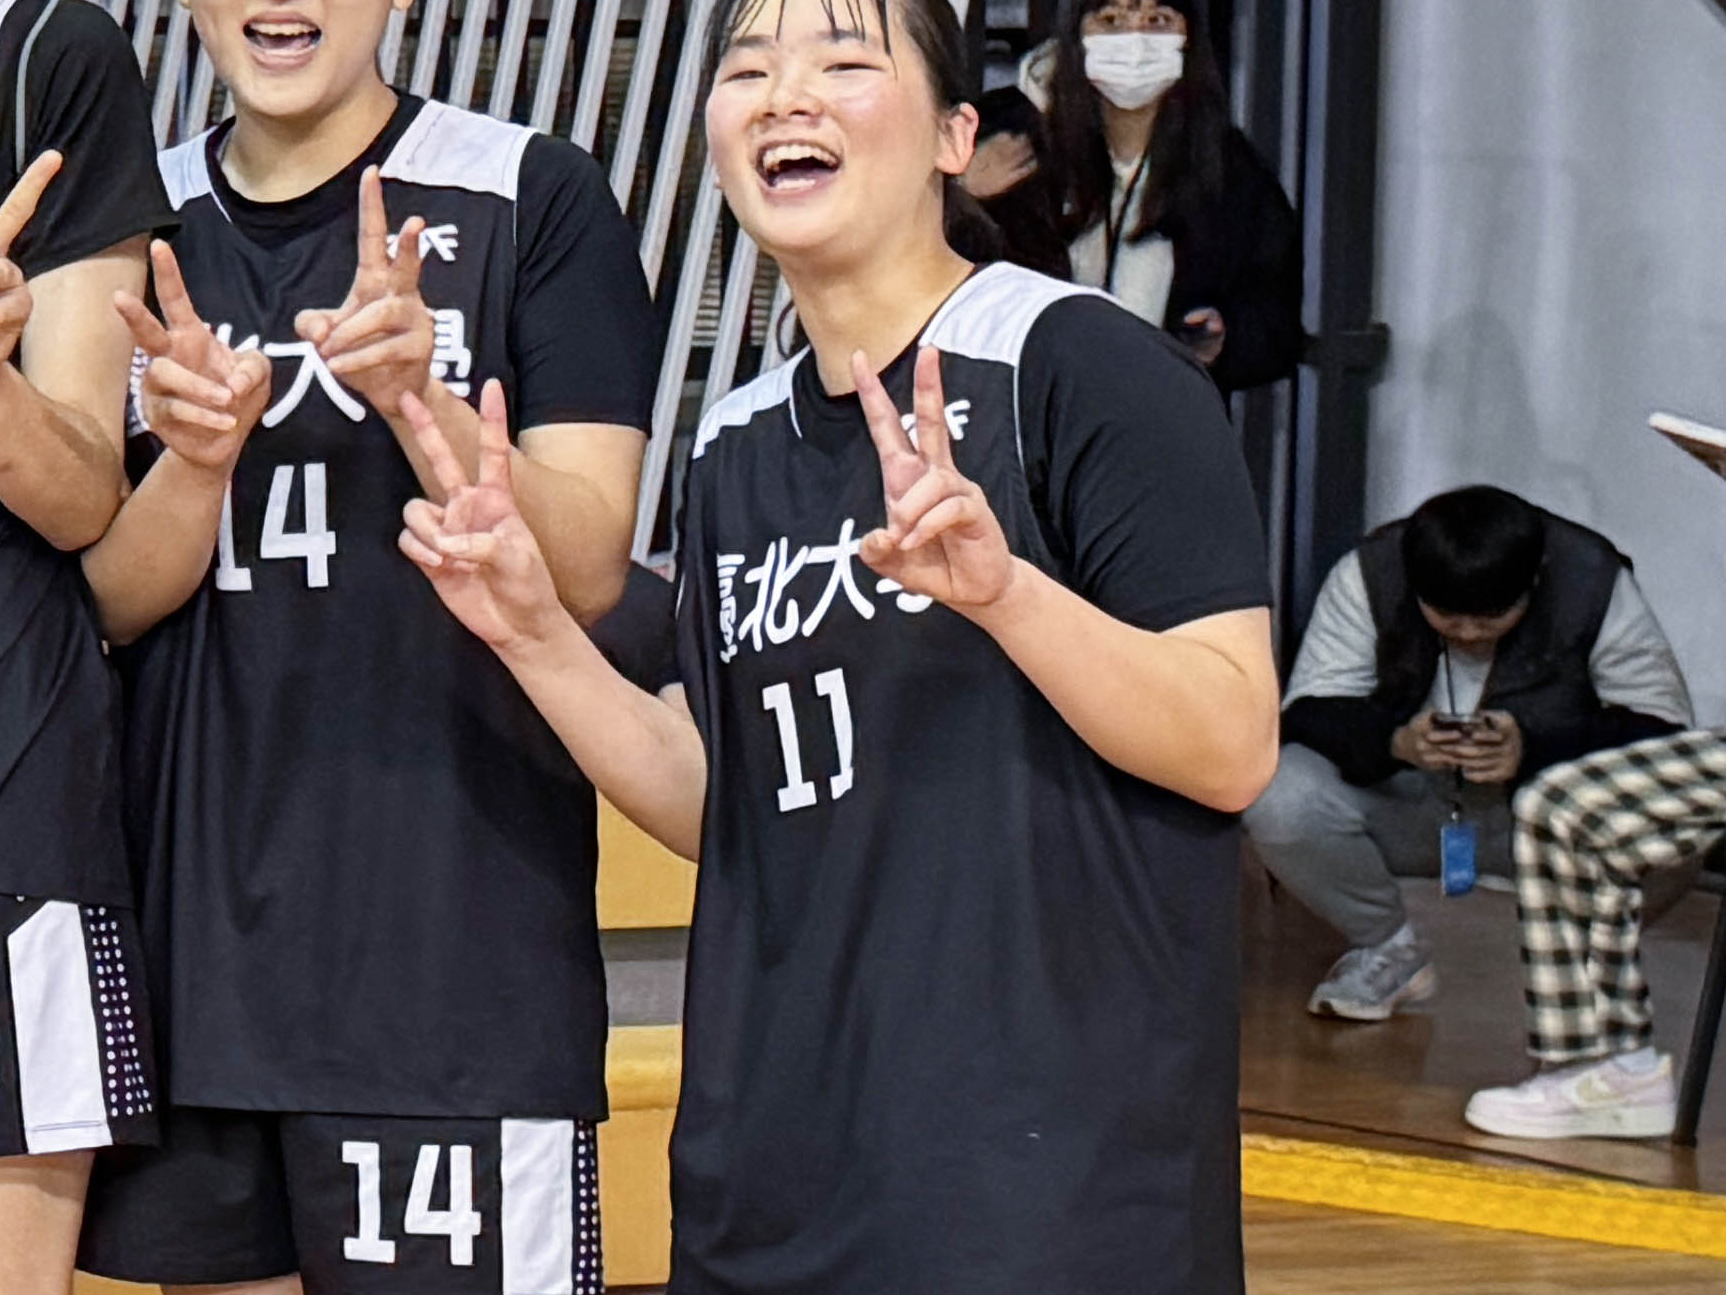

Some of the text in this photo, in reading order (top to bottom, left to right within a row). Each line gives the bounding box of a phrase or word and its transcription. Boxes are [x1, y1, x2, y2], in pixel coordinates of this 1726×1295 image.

[215, 462, 337, 592] 14
[762, 667, 855, 812] 11
[341, 1140, 482, 1266] 14
